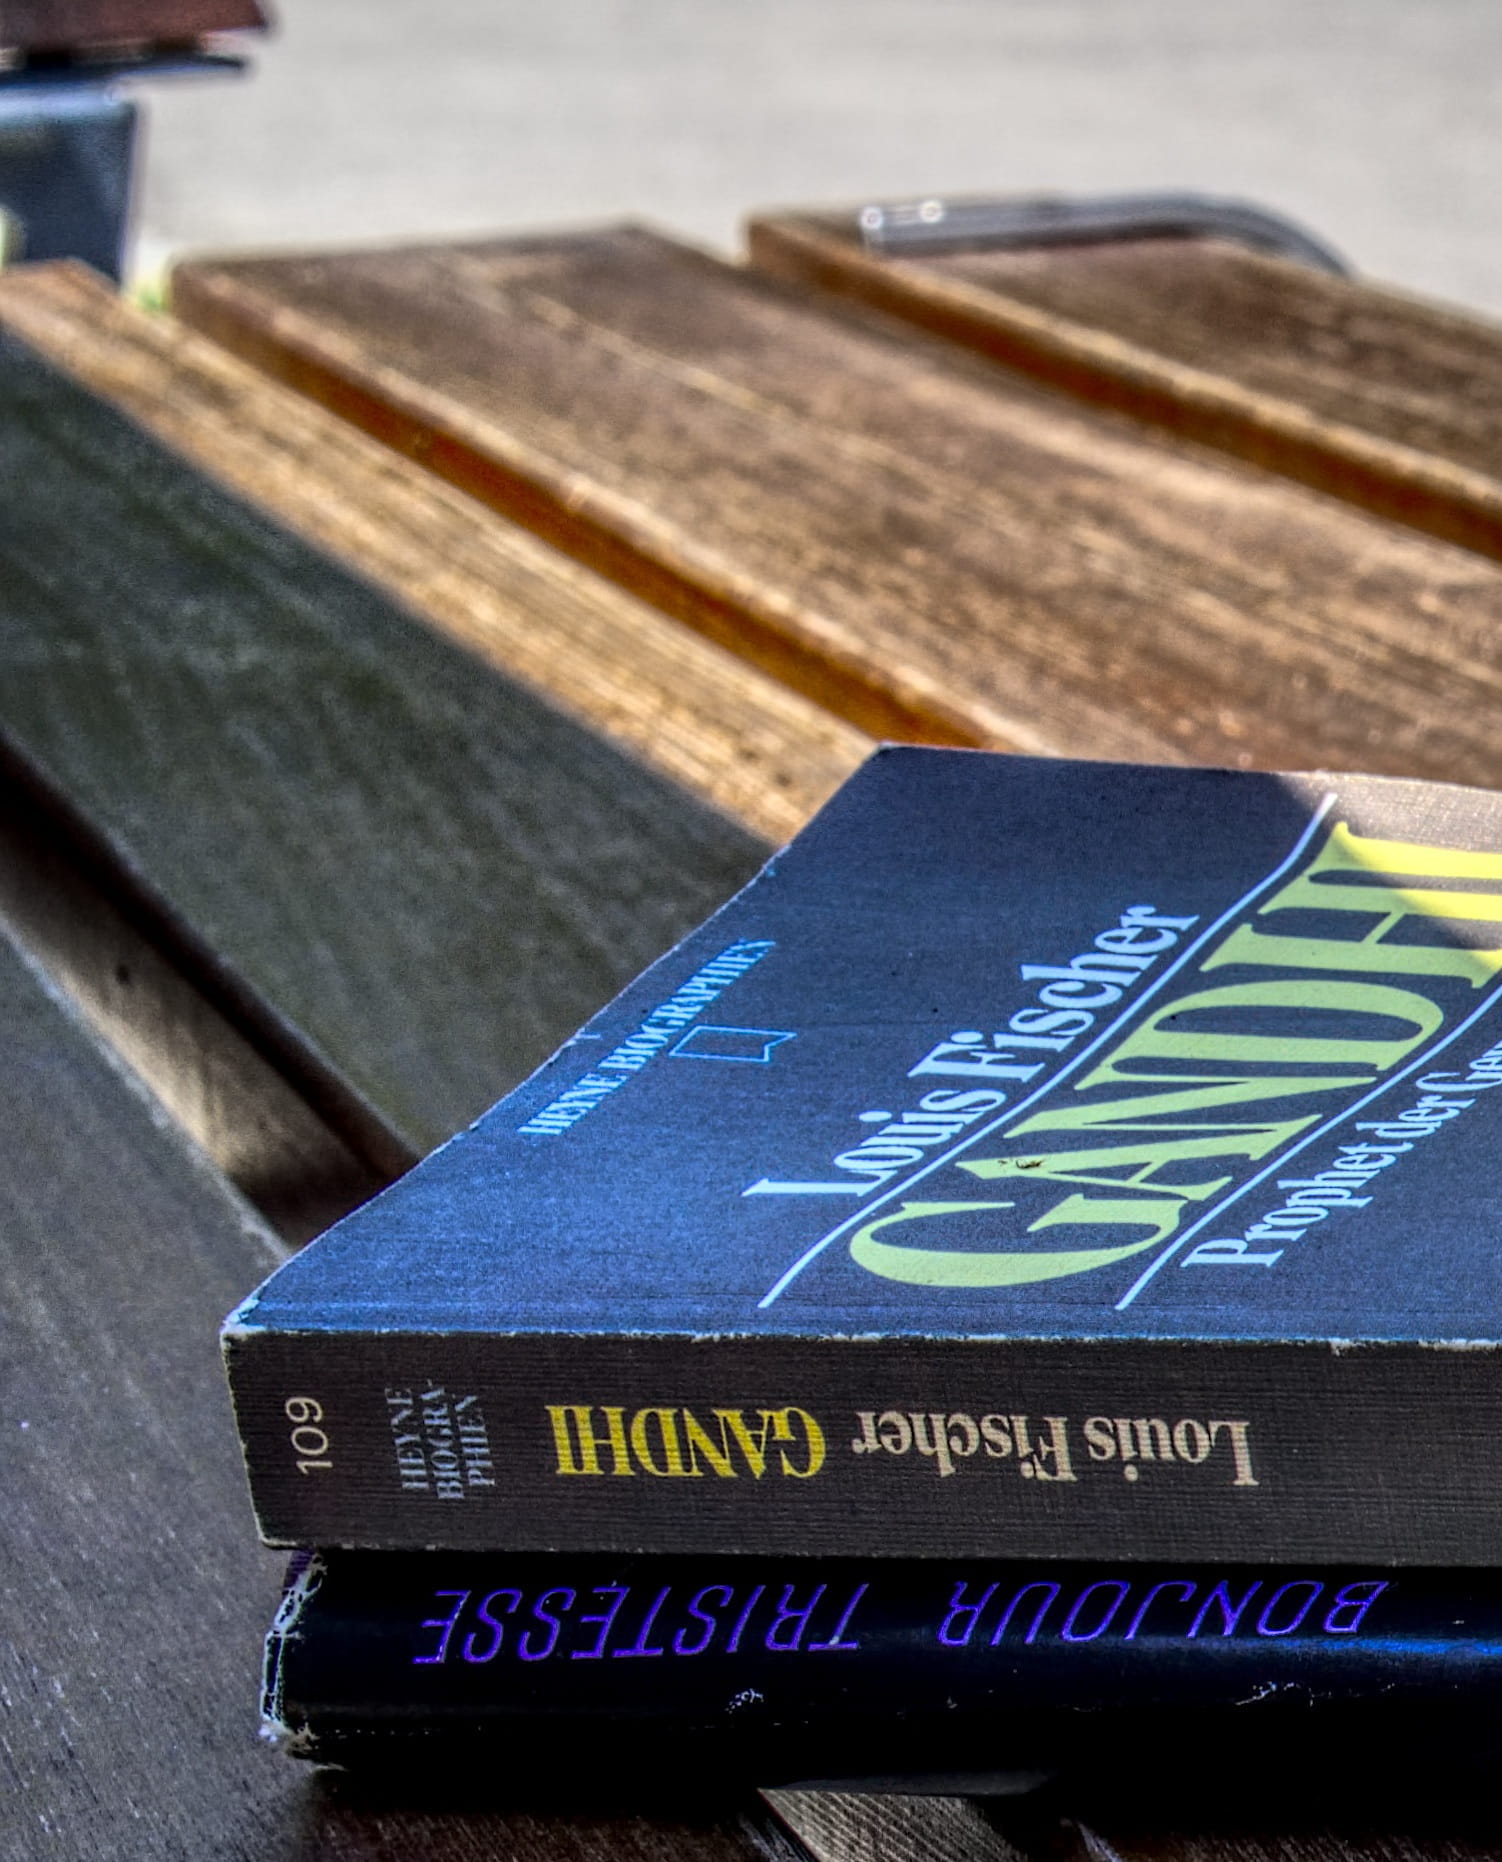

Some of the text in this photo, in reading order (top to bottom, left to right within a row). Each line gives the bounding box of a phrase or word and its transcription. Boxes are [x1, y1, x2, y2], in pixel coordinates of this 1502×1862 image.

[518, 939, 776, 1135] HEYNE BIOGRAPHIEN
[742, 904, 1199, 1199] Louis Fischer
[1180, 1142, 1414, 1268] Prophet
[1355, 1094, 1476, 1139] der
[284, 1396, 334, 1475] 109
[386, 1386, 430, 1492] HEYNE
[455, 1394, 496, 1487] PHIEN
[545, 1404, 1260, 1488] Louis Fischer GANDHI
[413, 1584, 870, 1664] TRISTESSE
[938, 1578, 1392, 1647] BONJOUR
